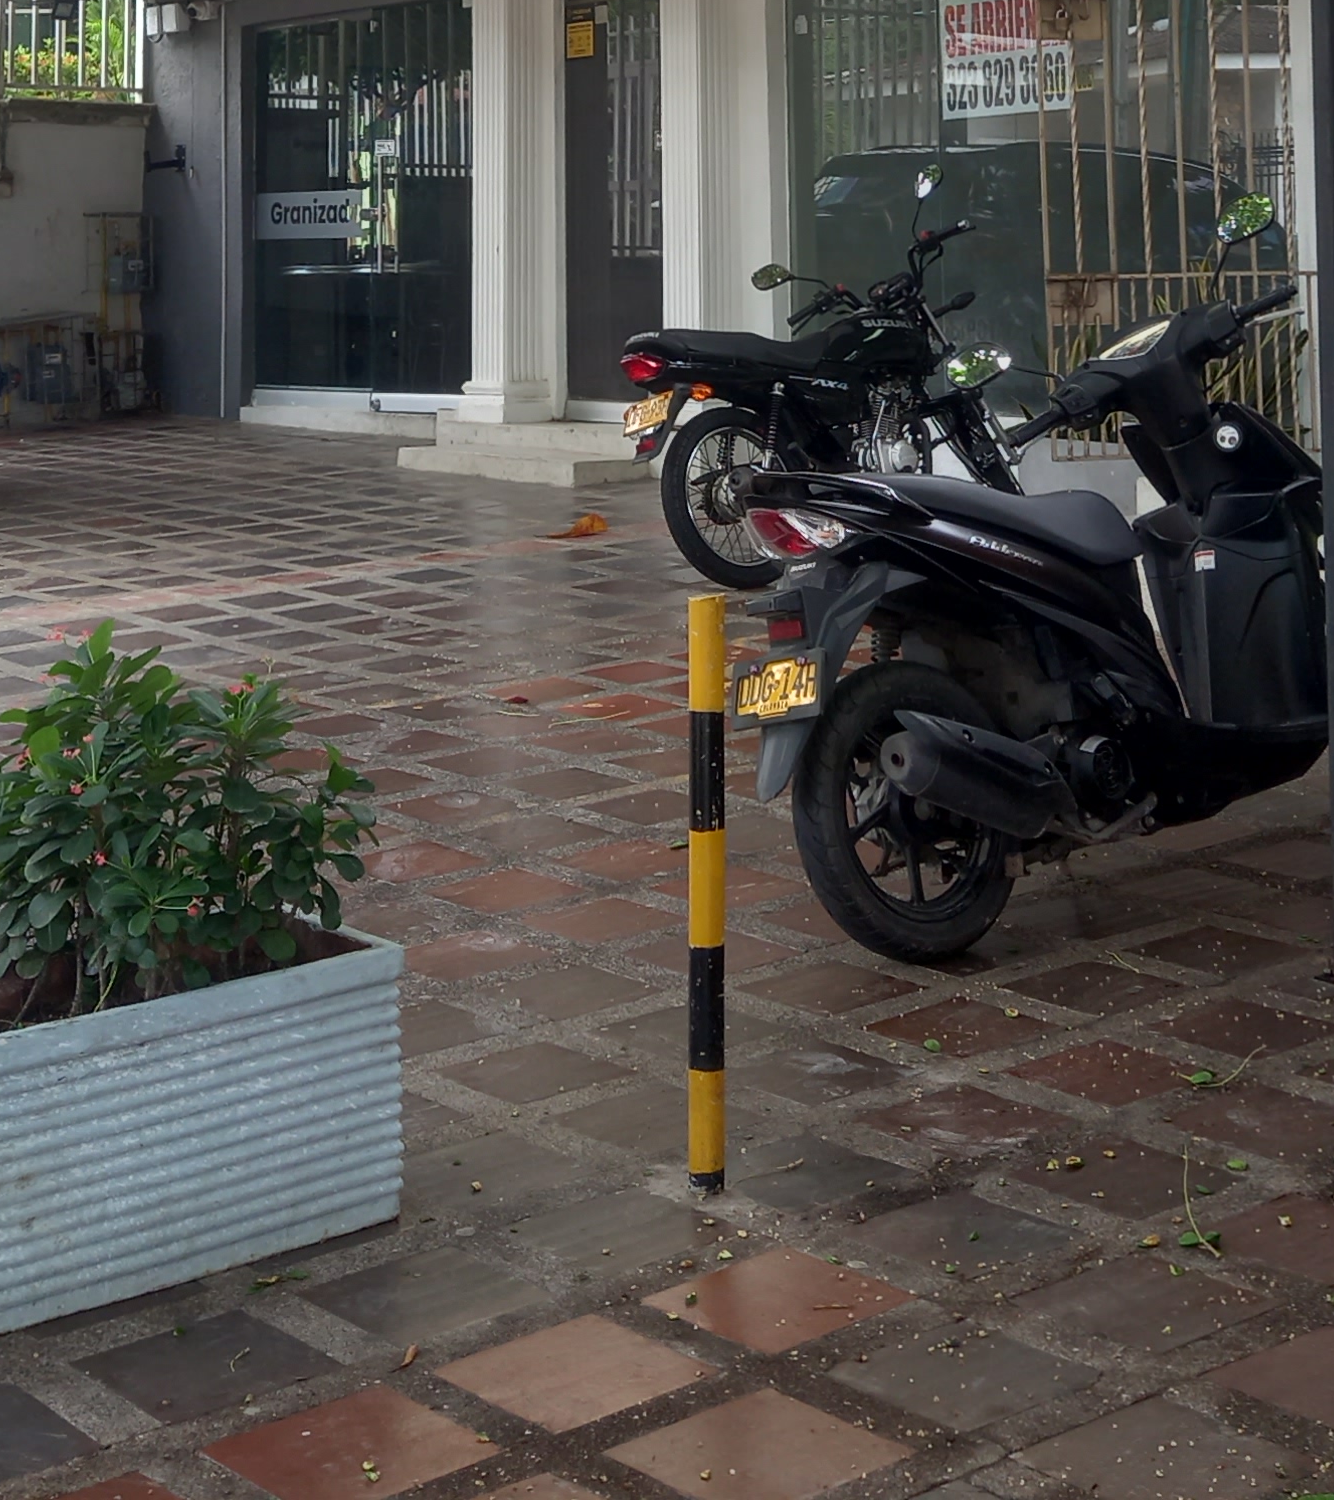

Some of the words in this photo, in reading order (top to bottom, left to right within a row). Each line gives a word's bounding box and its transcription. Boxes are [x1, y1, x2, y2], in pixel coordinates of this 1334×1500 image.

[945, 4, 967, 59] SE
[982, 56, 1016, 108] 829
[270, 198, 361, 225] Granizad
[860, 318, 914, 330] SUZUKI
